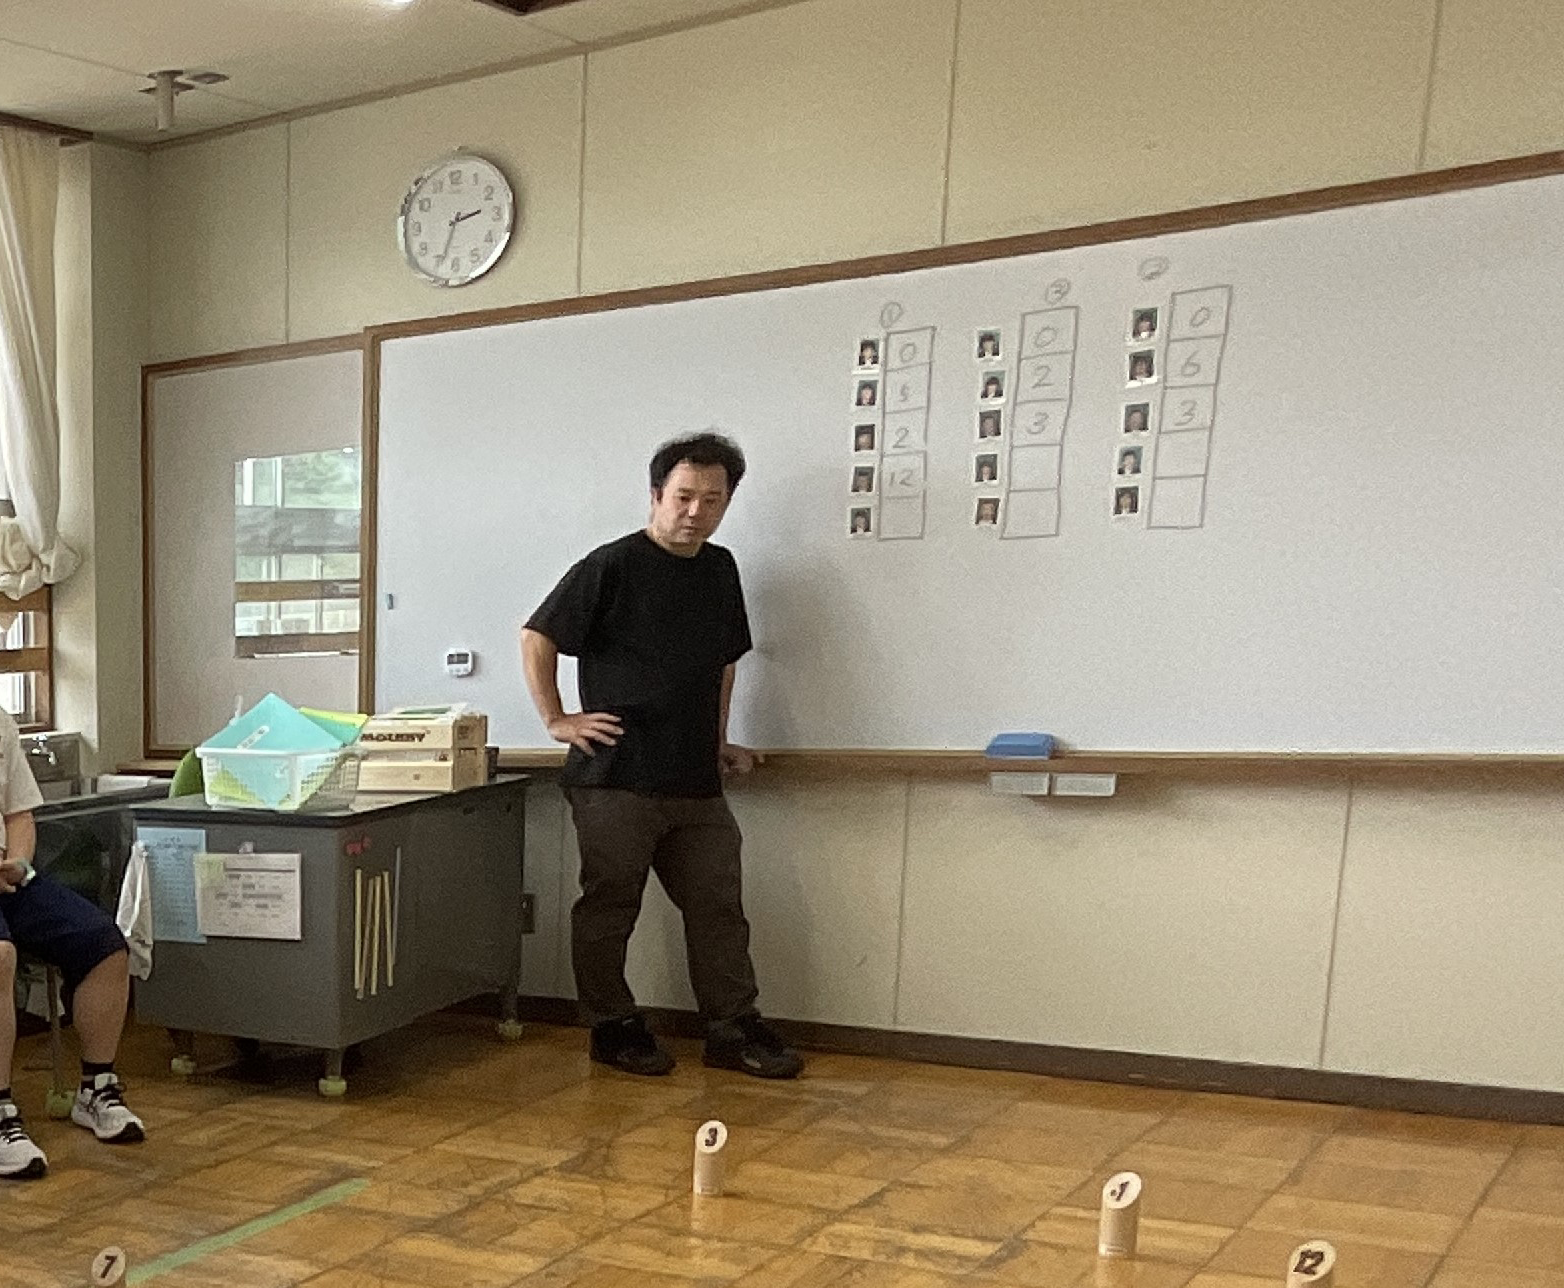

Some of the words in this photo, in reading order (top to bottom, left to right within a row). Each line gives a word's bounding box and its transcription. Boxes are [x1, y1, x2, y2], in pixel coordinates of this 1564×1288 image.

[484, 186, 494, 201] 2
[492, 206, 502, 222] 3
[899, 342, 917, 363] 0
[1180, 350, 1201, 377] 6
[1031, 365, 1055, 388] 2
[1025, 411, 1050, 435] 3
[1174, 400, 1198, 427] 3
[893, 427, 910, 449] 2
[888, 468, 914, 487] 12
[704, 1127, 718, 1147] 3
[100, 1254, 118, 1279] 7
[1293, 1249, 1325, 1276] 12
